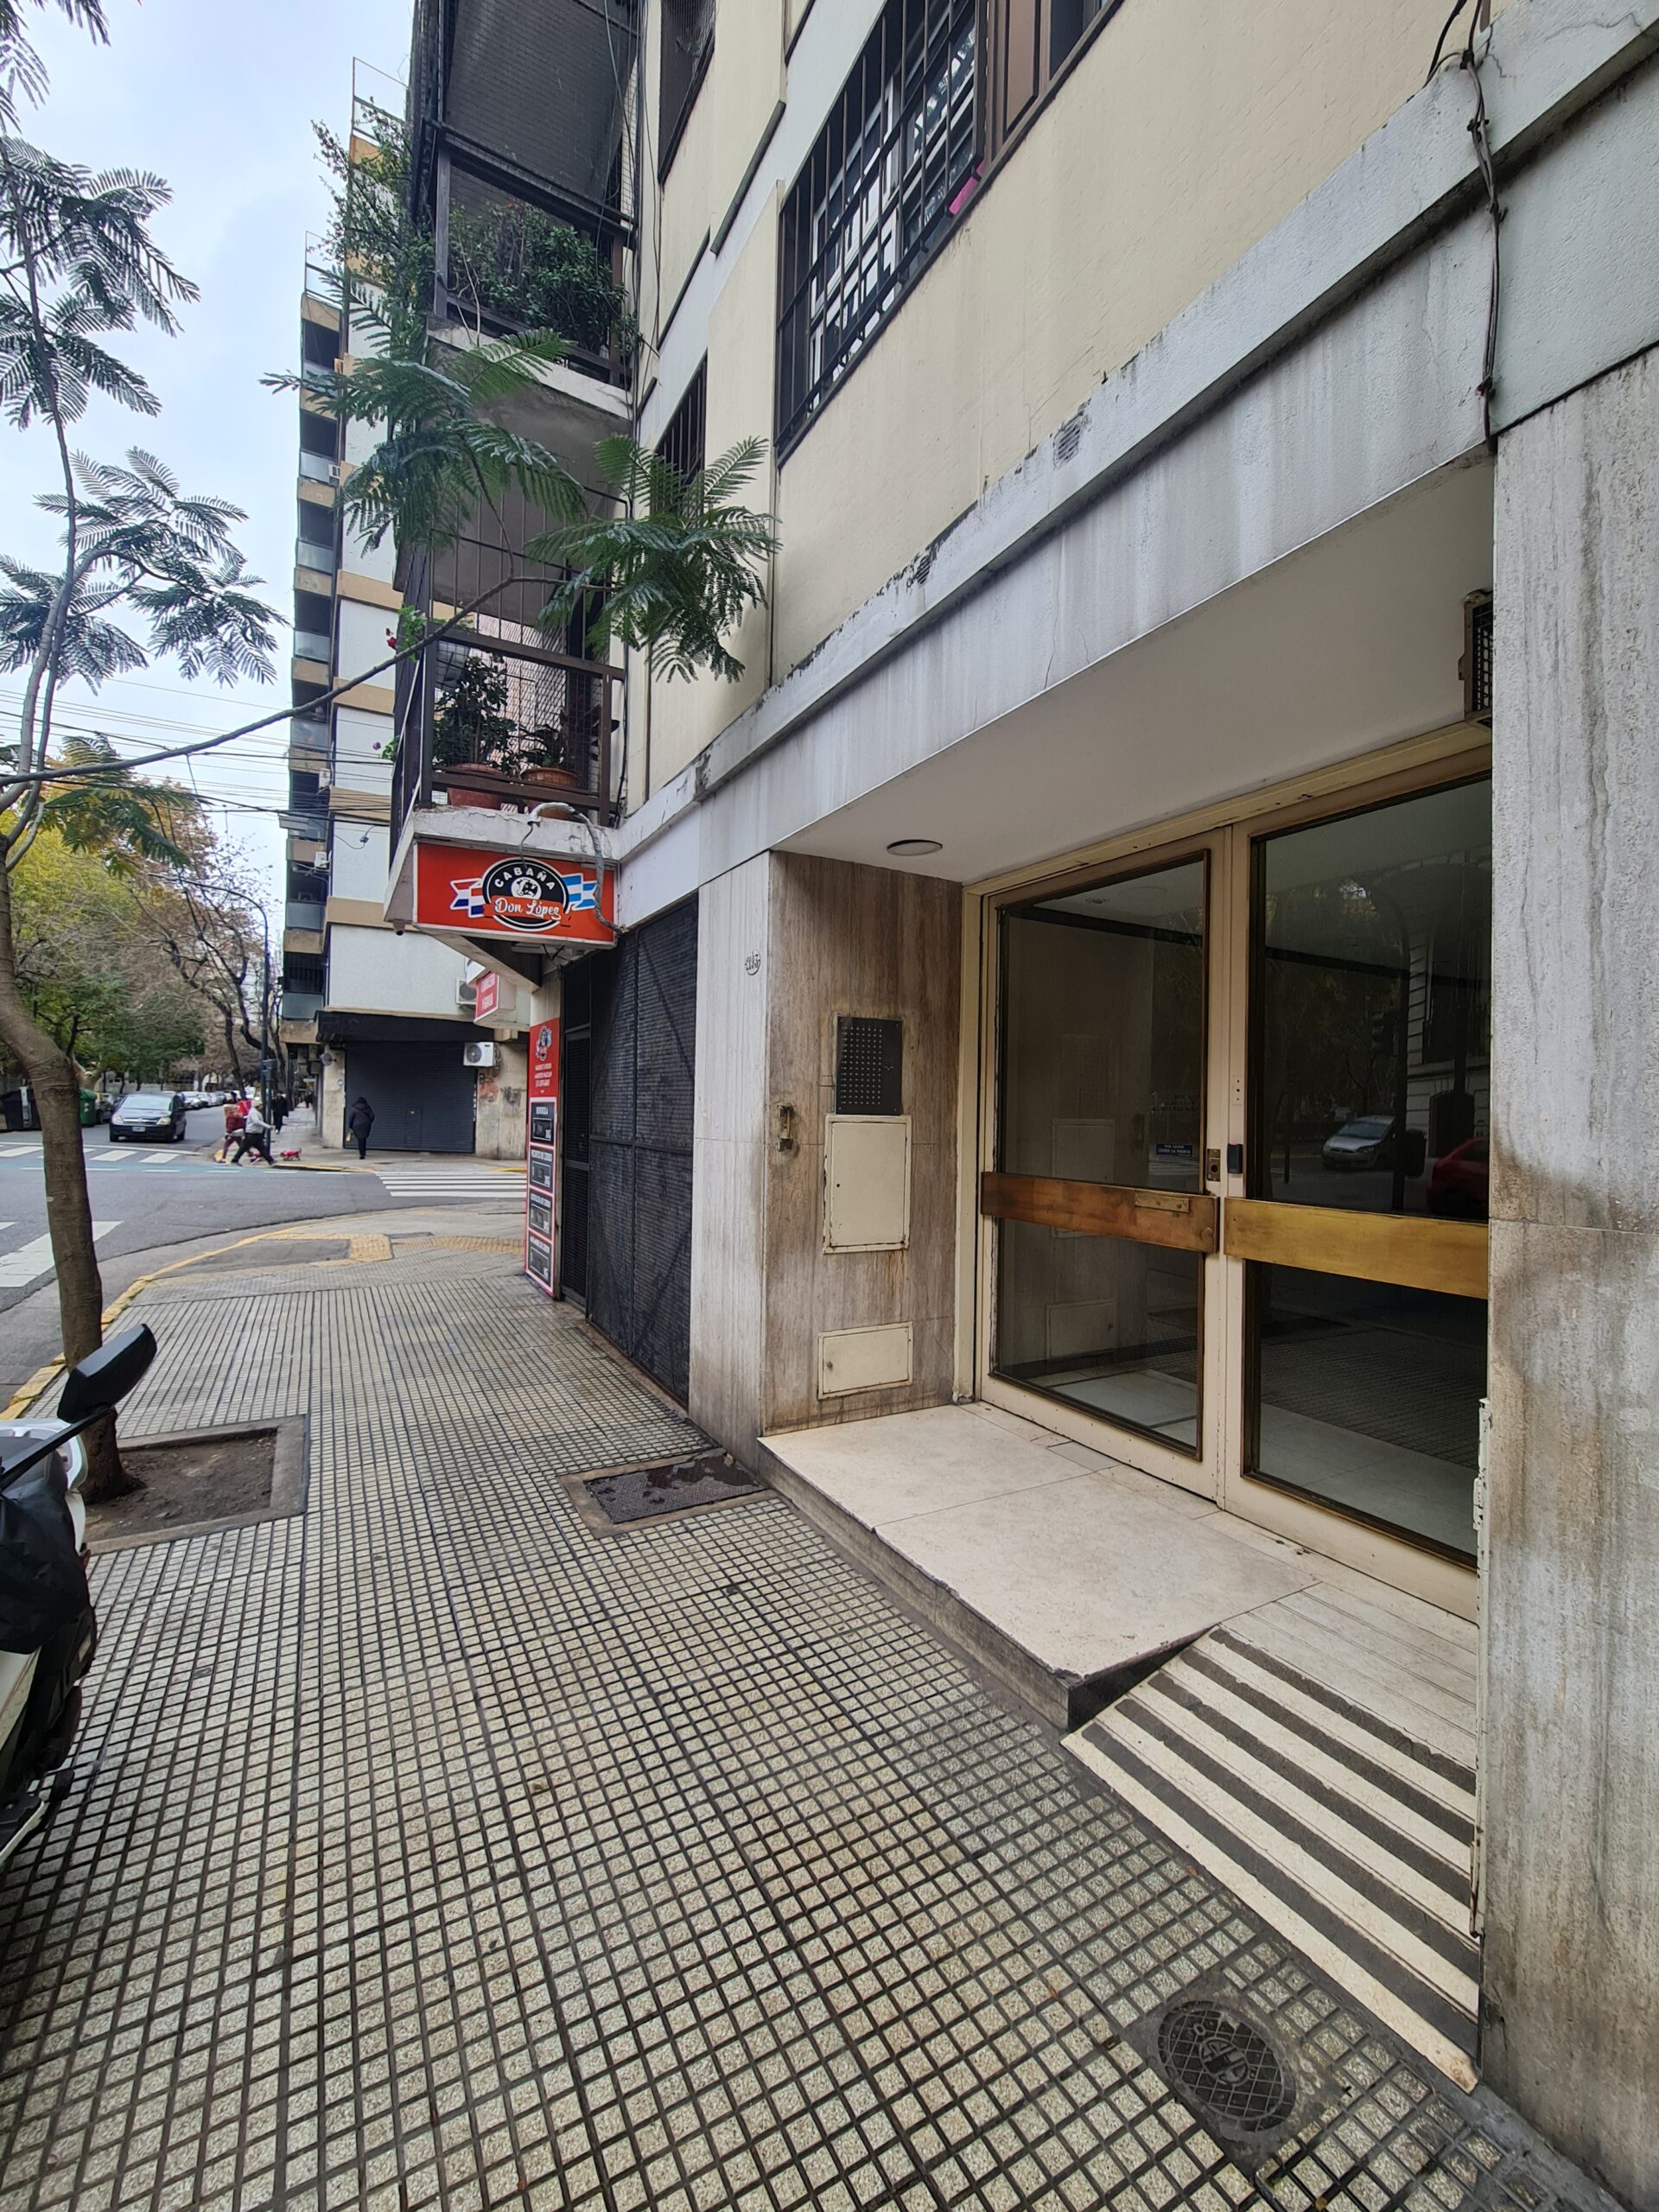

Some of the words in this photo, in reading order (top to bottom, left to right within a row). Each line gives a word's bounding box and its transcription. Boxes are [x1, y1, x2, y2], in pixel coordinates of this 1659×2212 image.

[494, 867, 556, 890] CABAÑA
[494, 897, 524, 913] Don
[525, 899, 562, 920] López
